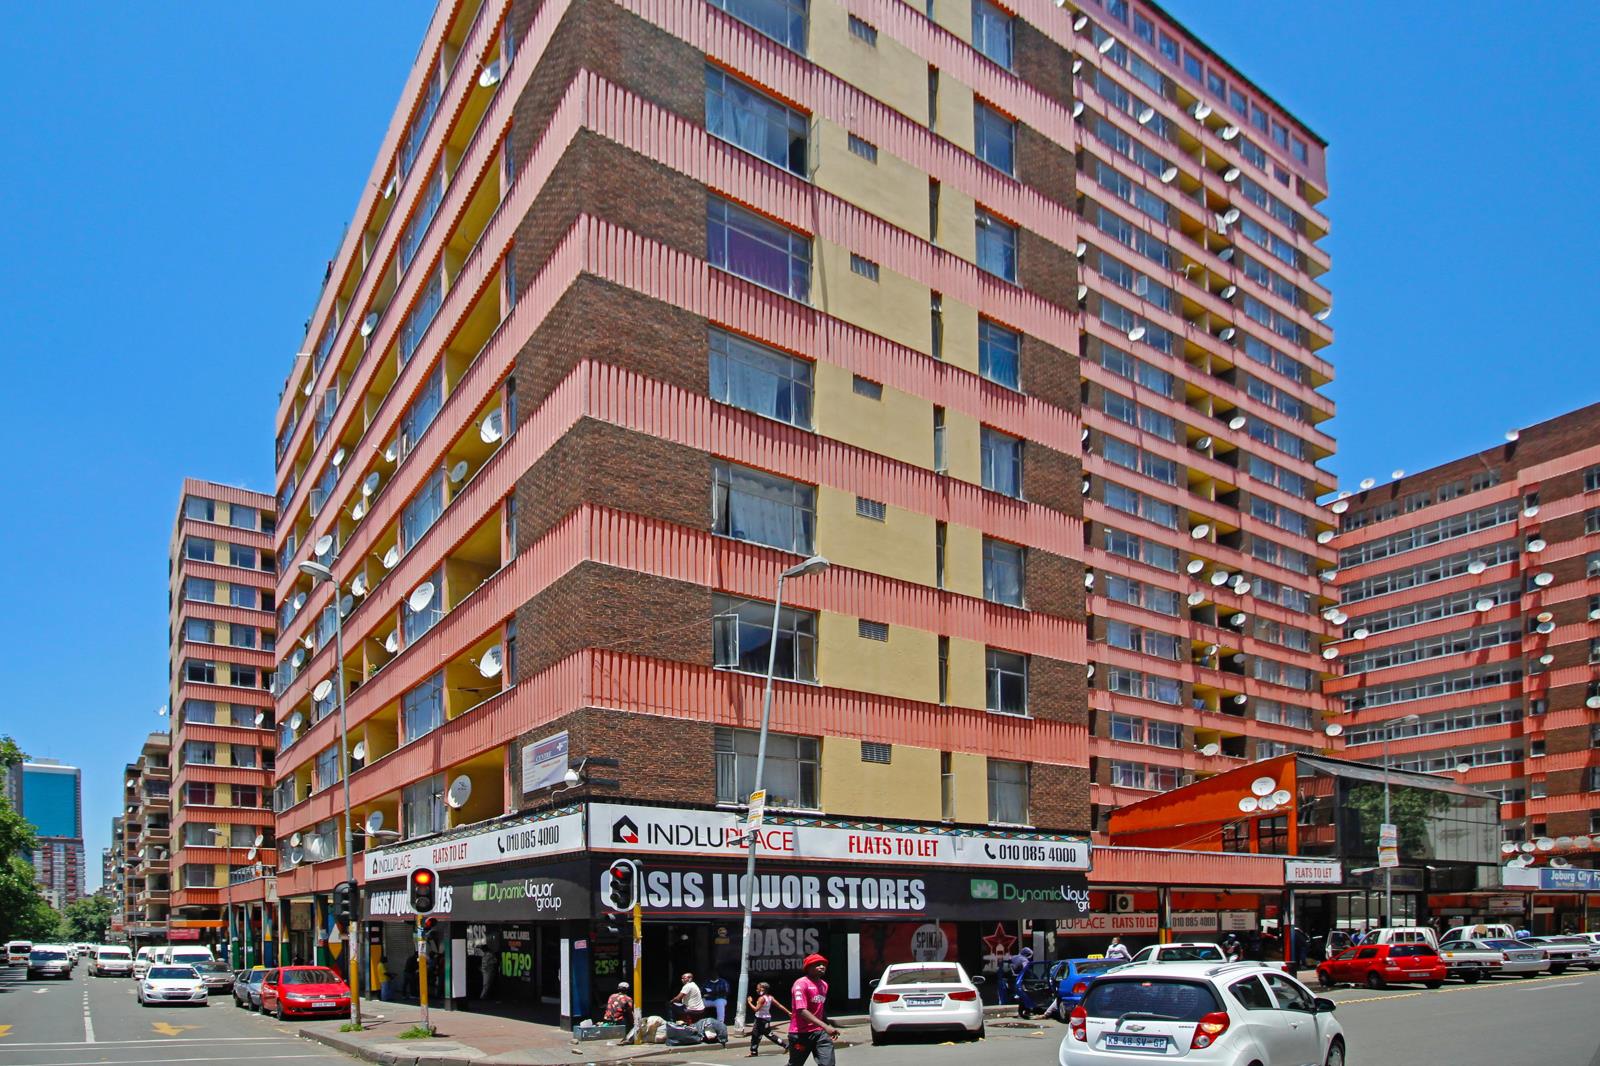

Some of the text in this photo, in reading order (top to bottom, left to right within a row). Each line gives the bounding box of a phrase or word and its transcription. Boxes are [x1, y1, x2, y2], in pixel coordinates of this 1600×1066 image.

[506, 825, 560, 851] 010 085 4000
[849, 835, 939, 857] FLATS TO LET
[432, 843, 468, 864] FLATS TO LET
[999, 844, 1076, 863] 010 085 4000
[1295, 867, 1332, 878] FLATS TO LET
[712, 873, 820, 911] LIQUOR
[827, 876, 926, 910] STORES
[536, 897, 562, 912] group
[1112, 917, 1134, 928] FLATS
[1136, 917, 1145, 928] TO
[1146, 917, 1157, 928] LET
[749, 928, 819, 956] OASIS
